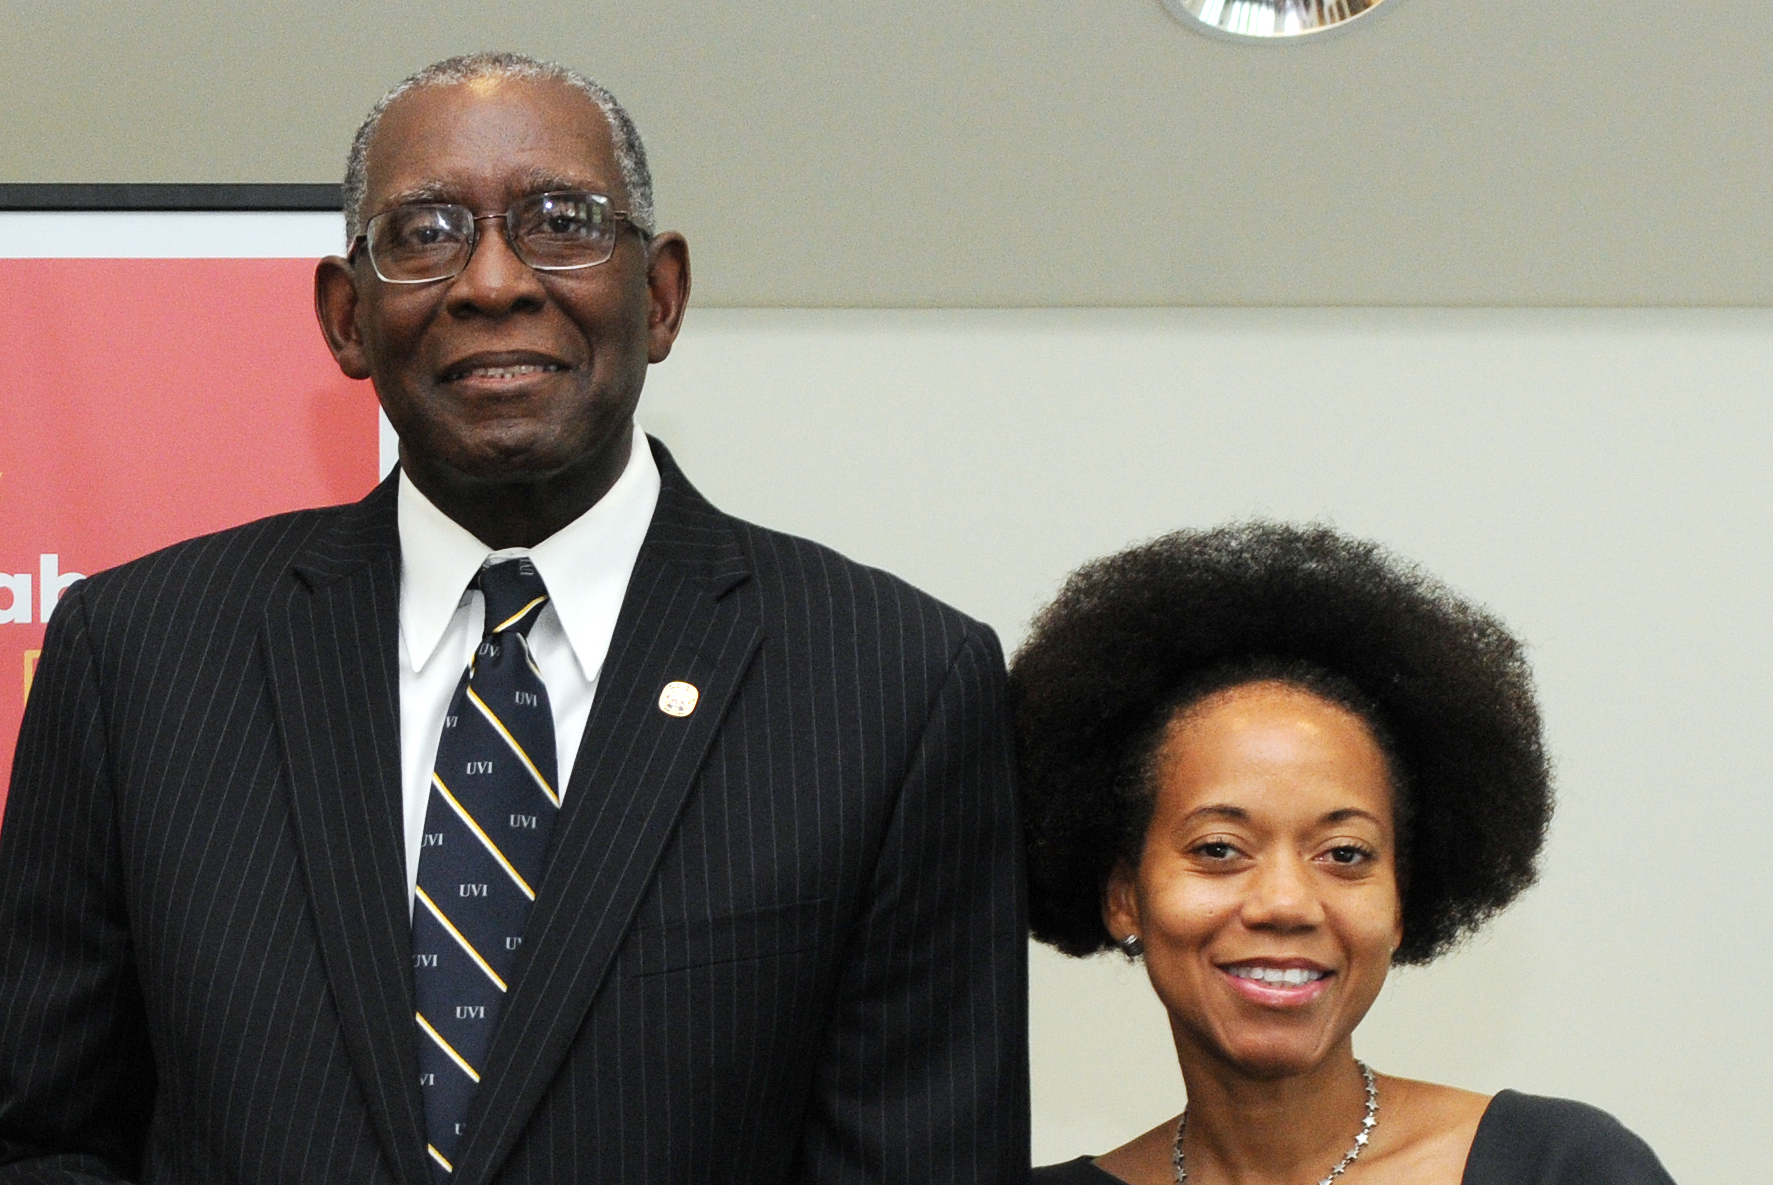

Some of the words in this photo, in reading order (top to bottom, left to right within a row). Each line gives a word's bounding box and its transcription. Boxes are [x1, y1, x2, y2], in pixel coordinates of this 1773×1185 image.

[515, 691, 538, 707] UVI
[444, 716, 459, 728] VI
[466, 762, 493, 774] UVI
[509, 814, 537, 828] UVI
[459, 884, 488, 897] UVI
[456, 1006, 485, 1018] UVI
[420, 1074, 435, 1085] VI
